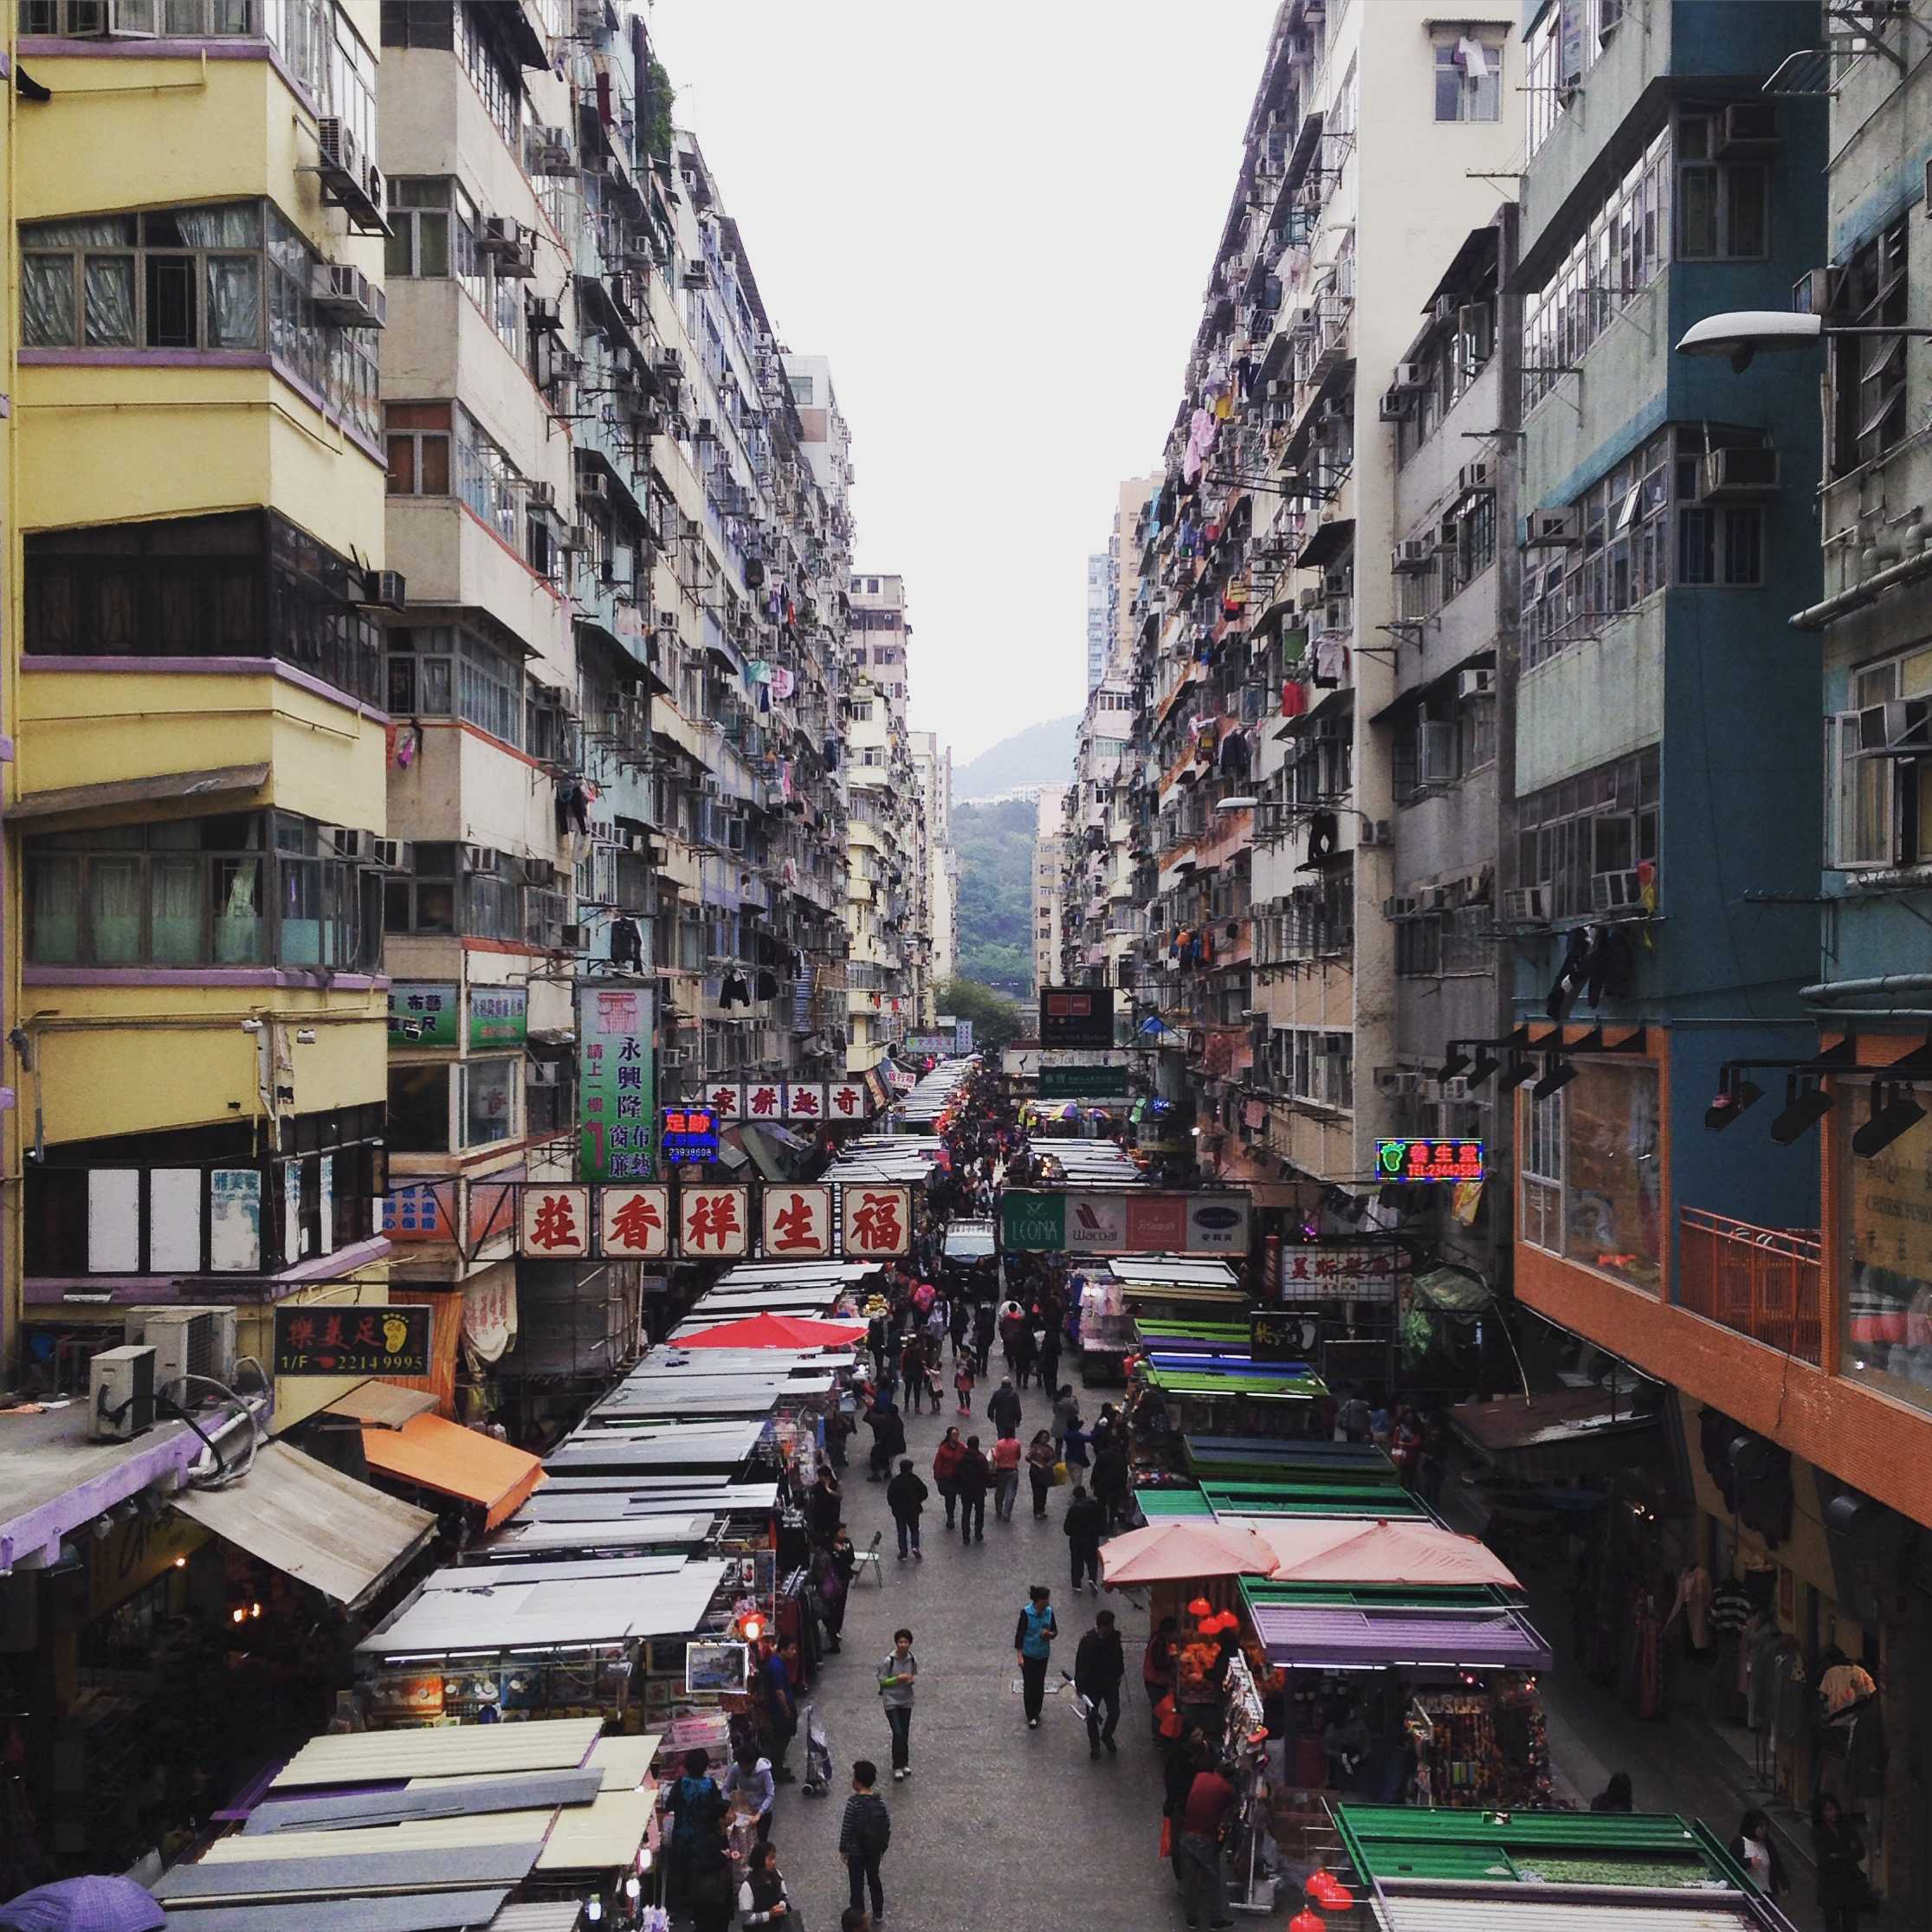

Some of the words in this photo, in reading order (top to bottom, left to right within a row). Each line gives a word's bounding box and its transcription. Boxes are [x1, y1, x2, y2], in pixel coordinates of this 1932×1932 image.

[617, 1037, 642, 1120] 永興隆
[281, 1355, 309, 1369] 1/F
[339, 1355, 378, 1370] 2214
